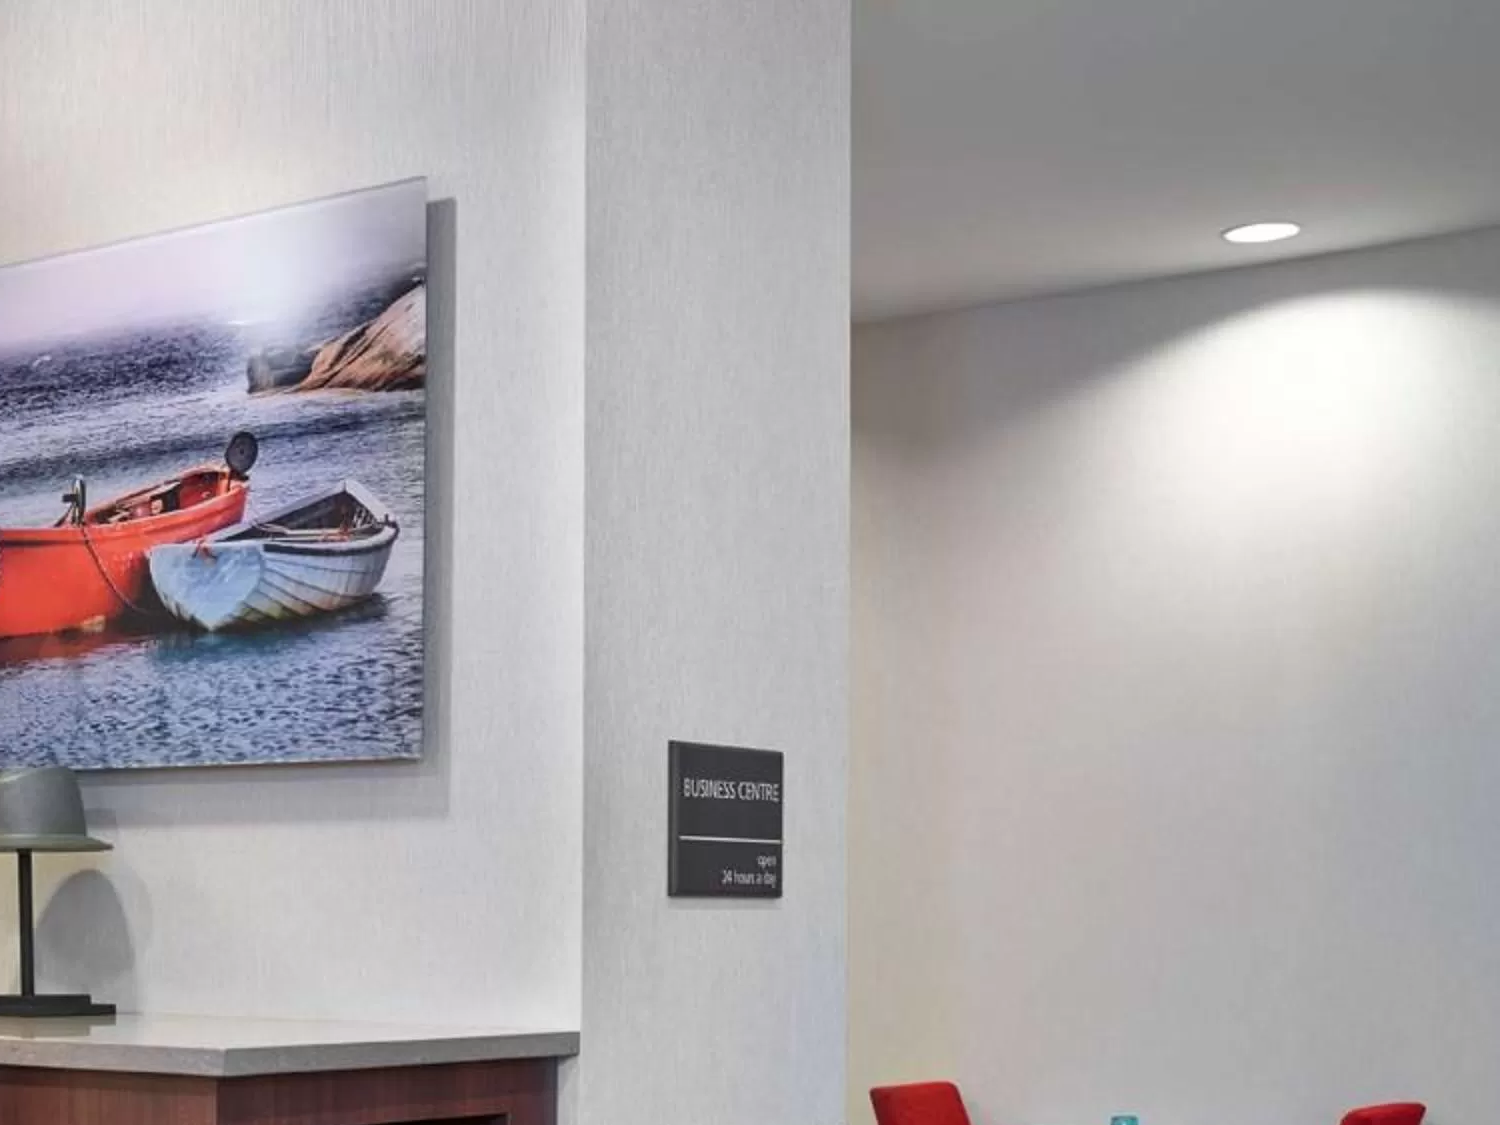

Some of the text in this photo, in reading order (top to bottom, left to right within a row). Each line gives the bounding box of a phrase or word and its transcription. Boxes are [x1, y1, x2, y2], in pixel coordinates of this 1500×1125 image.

[683, 777, 780, 802] BUSINESS CENTRE
[756, 855, 777, 869] open
[734, 869, 755, 885] hours
[763, 870, 777, 889] day
